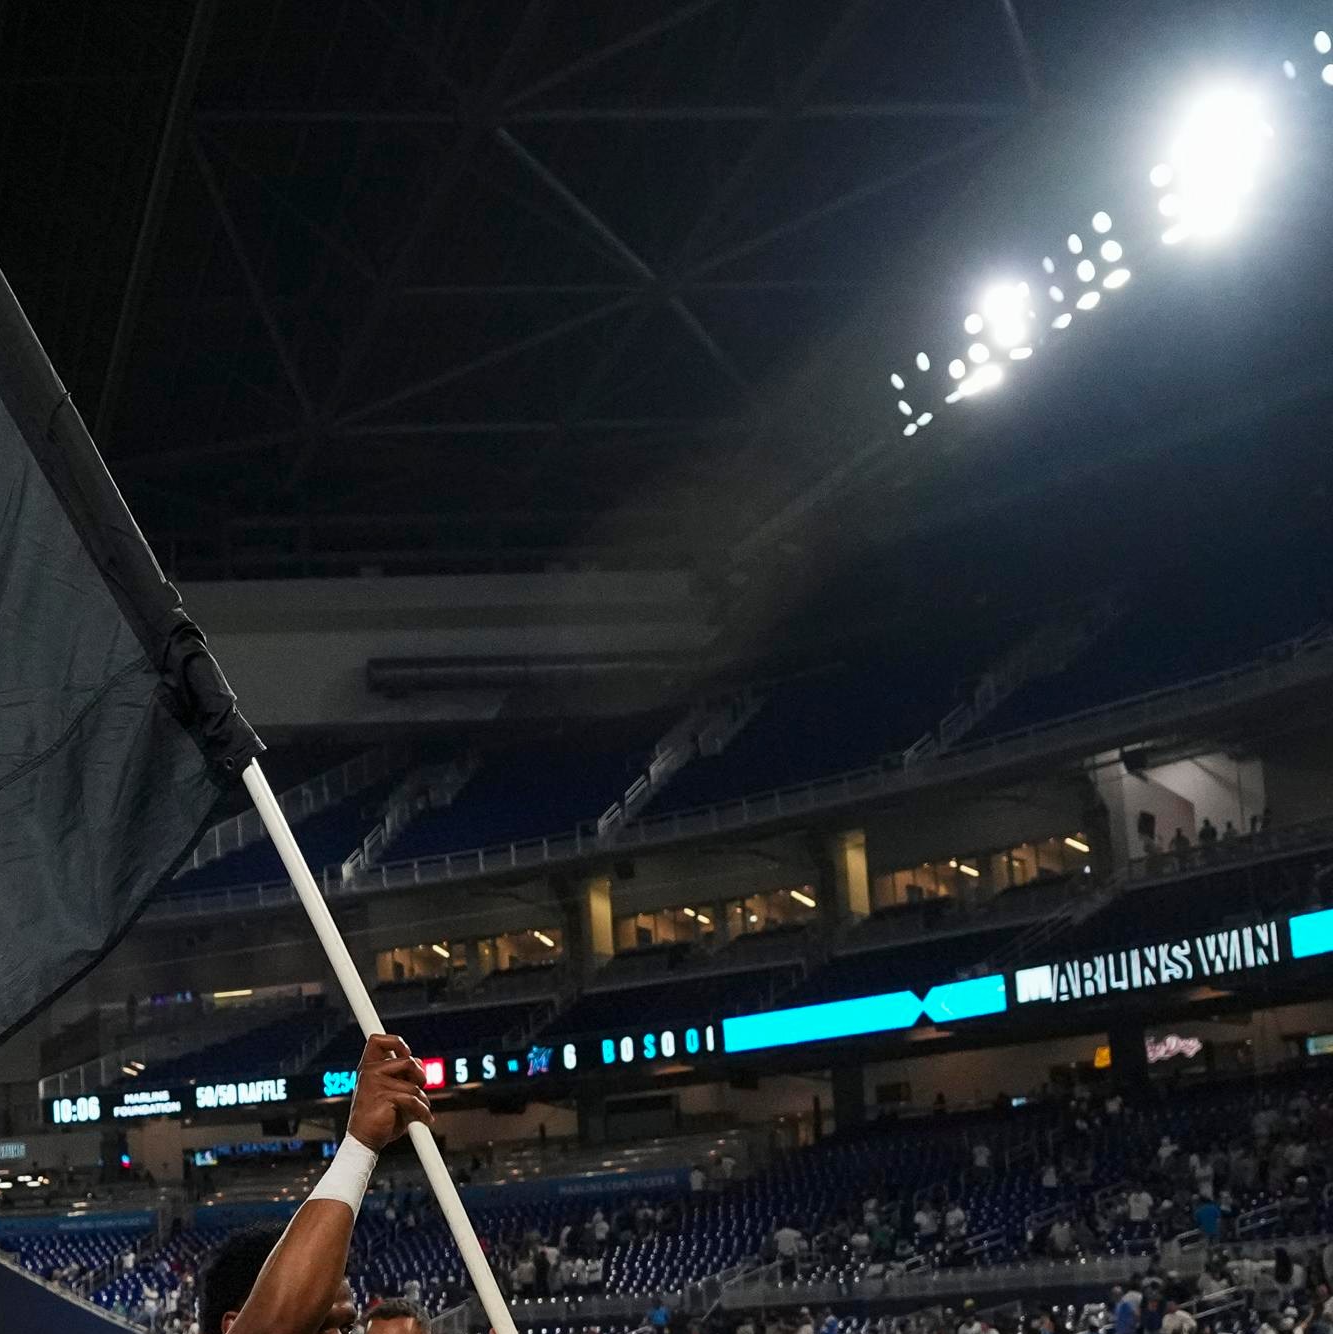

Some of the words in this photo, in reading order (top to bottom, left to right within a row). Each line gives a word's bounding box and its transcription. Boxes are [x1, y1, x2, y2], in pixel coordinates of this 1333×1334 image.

[1196, 922, 1280, 977] WIN
[455, 1058, 468, 1083] 5
[563, 1043, 577, 1069] 6
[602, 1039, 615, 1064] B
[643, 1033, 656, 1058] S
[53, 1096, 100, 1123] 10:06
[196, 1083, 237, 1108] 50/50
[238, 1079, 287, 1104] RAFFLE
[113, 1101, 181, 1118] FOUNDATION
